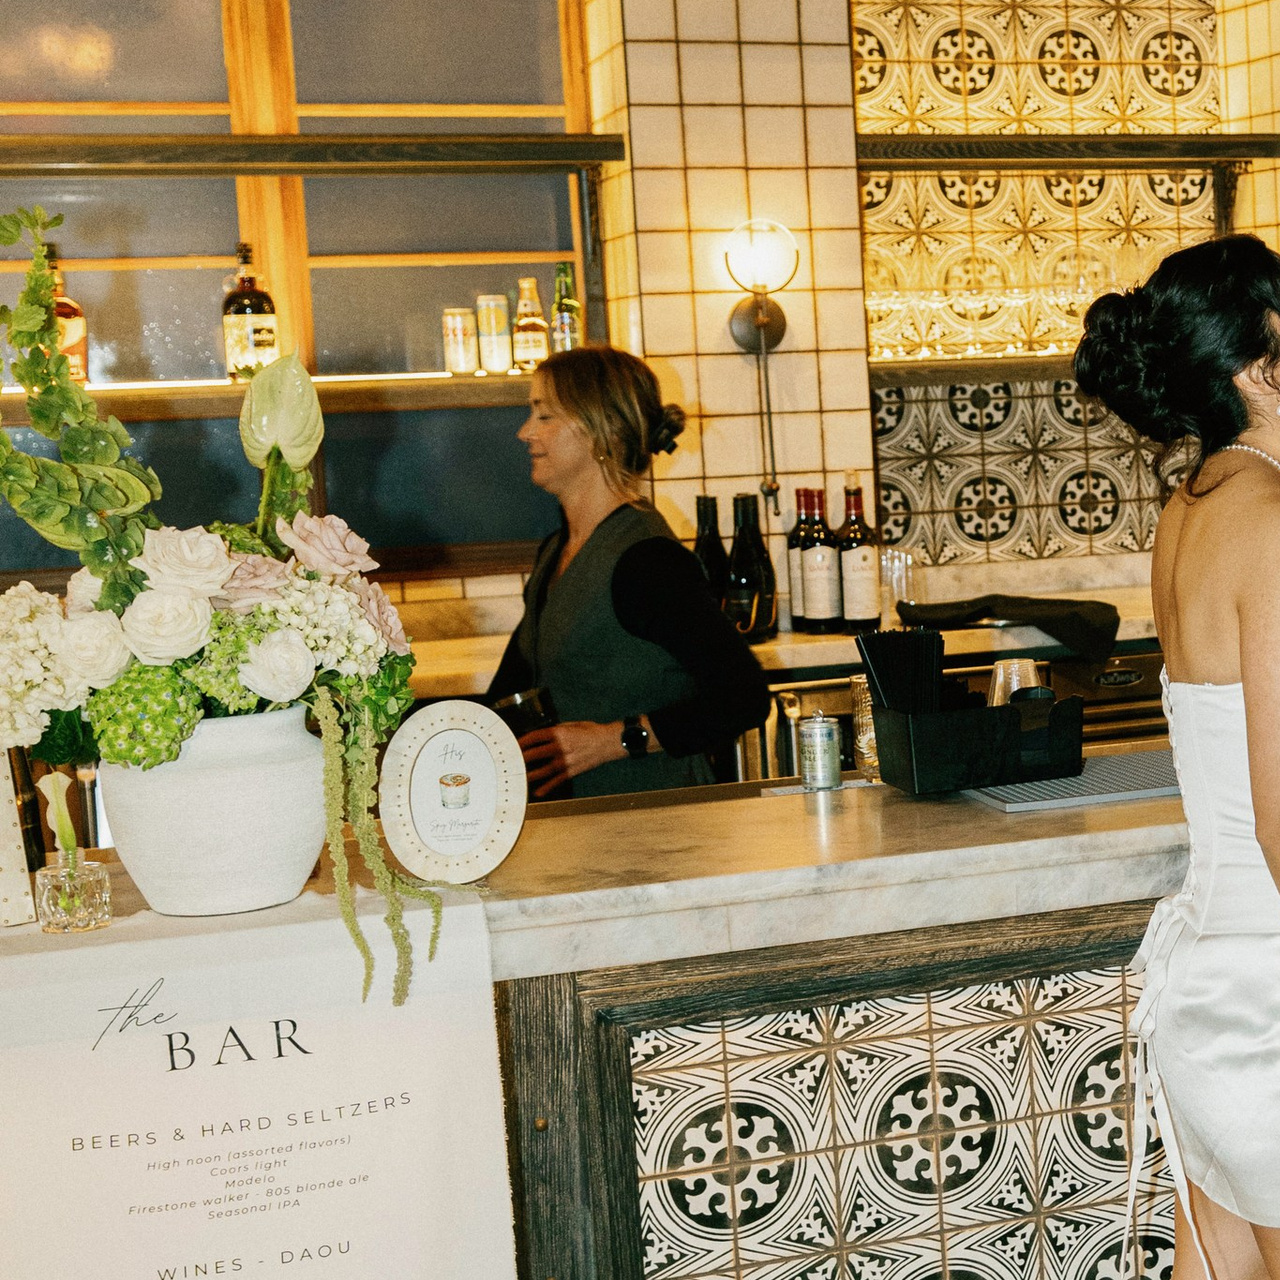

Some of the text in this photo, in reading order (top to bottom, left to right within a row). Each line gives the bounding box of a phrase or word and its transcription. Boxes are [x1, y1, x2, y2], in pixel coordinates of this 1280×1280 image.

[92, 977, 178, 1051] the
[162, 1019, 314, 1072] BAR
[71, 1092, 412, 1151] BEERS & HARD SELTZERS
[147, 1135, 351, 1172] High noon (assorted flavors)
[210, 1159, 288, 1177] Coors light
[128, 1200, 197, 1215] Firestone
[203, 1192, 250, 1206] walker
[265, 1187, 291, 1198] 805
[296, 1179, 344, 1194] blonde
[349, 1173, 370, 1185] ale
[225, 1174, 276, 1189] Modelo
[208, 1199, 301, 1220] Seasonal IPA
[281, 1241, 351, 1264] DAOU
